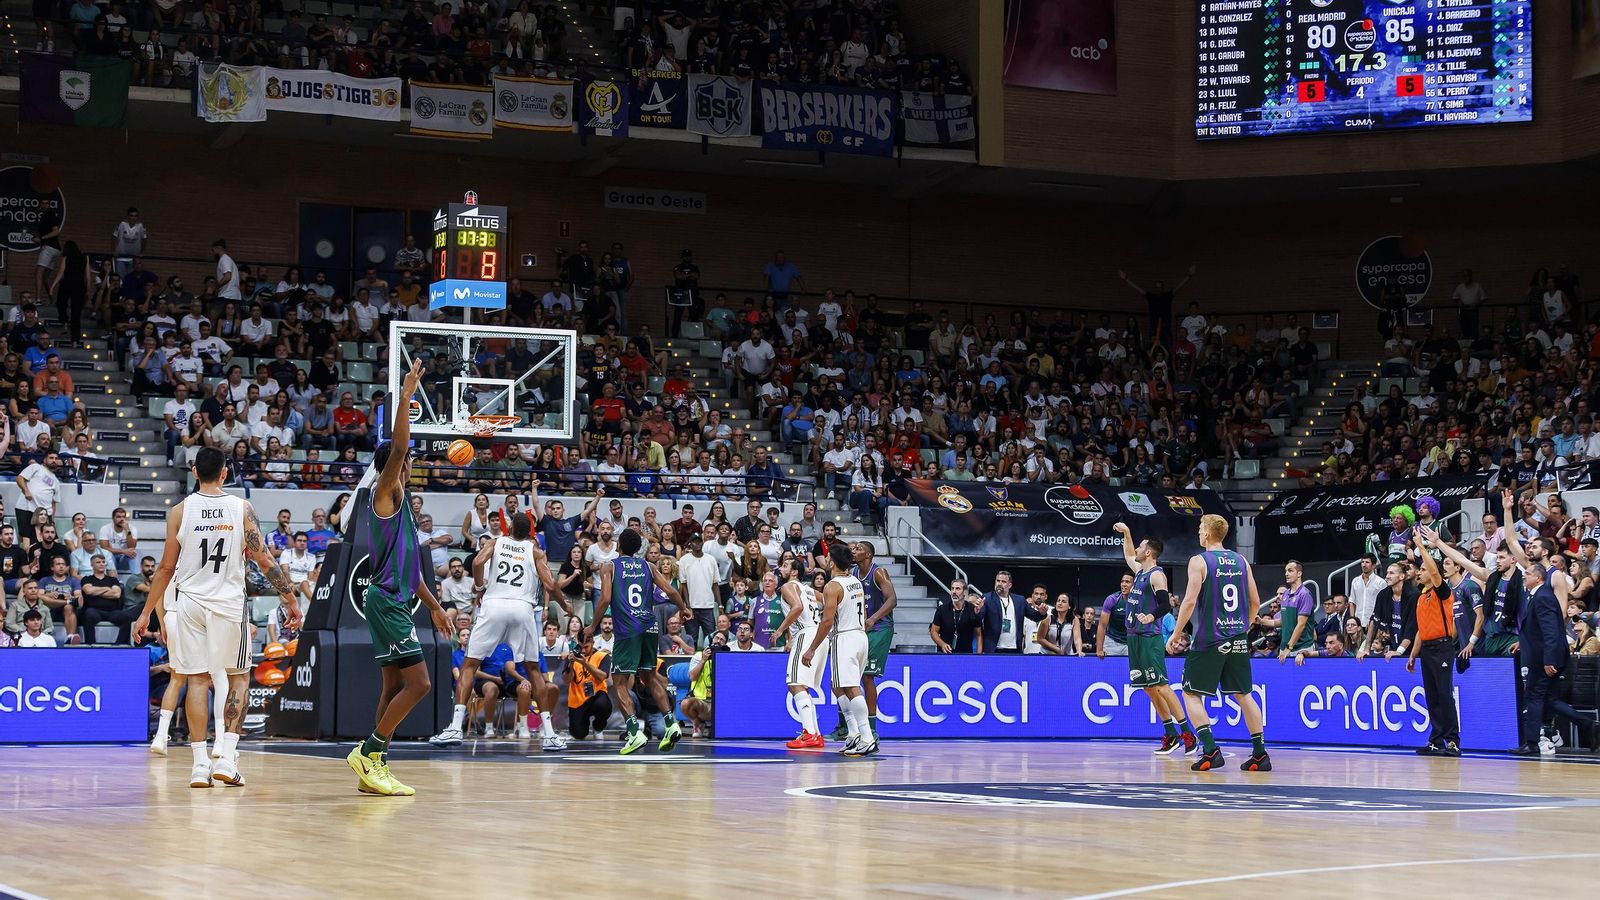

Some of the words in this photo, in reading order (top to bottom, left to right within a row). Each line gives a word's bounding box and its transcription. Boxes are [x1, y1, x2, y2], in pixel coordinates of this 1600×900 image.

[1201, 4, 1206, 12] 8
[1210, 1, 1262, 12] RATHAN-MAYES
[1383, 7, 1415, 16] UNICAJA
[1210, 16, 1217, 24] H.
[1218, 13, 1252, 23] GONZALEZ
[1299, 14, 1317, 23] REAL
[1318, 12, 1346, 22] MADRID
[1428, 13, 1433, 21] 7
[1437, 12, 1445, 20] J.
[1445, 9, 1481, 19] BARREIRO
[1517, 7, 1523, 15] 5
[1210, 28, 1217, 36] D.
[1218, 27, 1237, 35] MUSA
[1385, 18, 1415, 43] 85
[1437, 25, 1445, 33] A.
[1446, 23, 1464, 32] DIAZ
[1307, 25, 1336, 49] 80
[1426, 39, 1434, 47] 11
[1437, 38, 1445, 46] T.
[1445, 36, 1473, 45] CARTER
[1218, 39, 1236, 47] DECK
[1070, 45, 1101, 60] acb
[1218, 51, 1245, 59] GARUBA
[1437, 51, 1445, 59] N.
[1334, 52, 1387, 72] 17.3
[1425, 64, 1435, 72] 33
[1437, 63, 1445, 71] K.
[1446, 61, 1467, 71] TILLIE
[1210, 65, 1217, 73] S.
[1218, 64, 1238, 72] IBAKA
[1220, 76, 1250, 84] TAVARES
[1346, 77, 1374, 85] PERIODO
[1437, 76, 1445, 84] D.
[1446, 73, 1477, 83] KRAVISH
[1405, 78, 1415, 92] 5
[1218, 89, 1237, 97] LLULL
[1306, 84, 1315, 98] 5
[1356, 86, 1365, 99] 4
[1437, 88, 1445, 96] K.
[1446, 87, 1470, 96] PERRY
[698, 95, 742, 121] BSK
[1218, 101, 1236, 109] FELIZ
[1426, 102, 1435, 110] 77
[1437, 101, 1445, 109] Y.
[1445, 100, 1464, 109] SIMA
[439, 109, 467, 117] Familia
[761, 87, 891, 141] BERSERKERS
[1218, 113, 1242, 122] NDIAYE
[1444, 111, 1477, 121] NAVARRO
[584, 117, 623, 129] Madrid
[652, 115, 672, 123] TOUR
[1218, 126, 1241, 134] MATEO
[609, 192, 654, 205] Grada
[661, 195, 703, 208] Oeste
[434, 218, 447, 231] LOTUS
[456, 217, 499, 229] LOTUS
[481, 251, 496, 279] 8
[1362, 262, 1425, 274] supercopa
[1368, 274, 1425, 286] enesa
[474, 291, 501, 299] Movistar
[1326, 494, 1376, 507] endesa
[201, 509, 224, 519] DECK
[1280, 525, 1298, 534] Wilson
[1029, 534, 1124, 546] #SupercopaEndes
[199, 538, 228, 573] 14
[621, 561, 642, 570] Taylor
[496, 561, 525, 587] 22
[316, 583, 331, 600] acb
[628, 584, 642, 607] 6
[1223, 584, 1238, 612] 9
[1127, 612, 1133, 624] 4
[1495, 611, 1502, 622] 7
[1394, 634, 1398, 643] 1
[295, 661, 312, 687] acb
[0, 678, 101, 712] desa
[1299, 670, 1461, 733] endes
